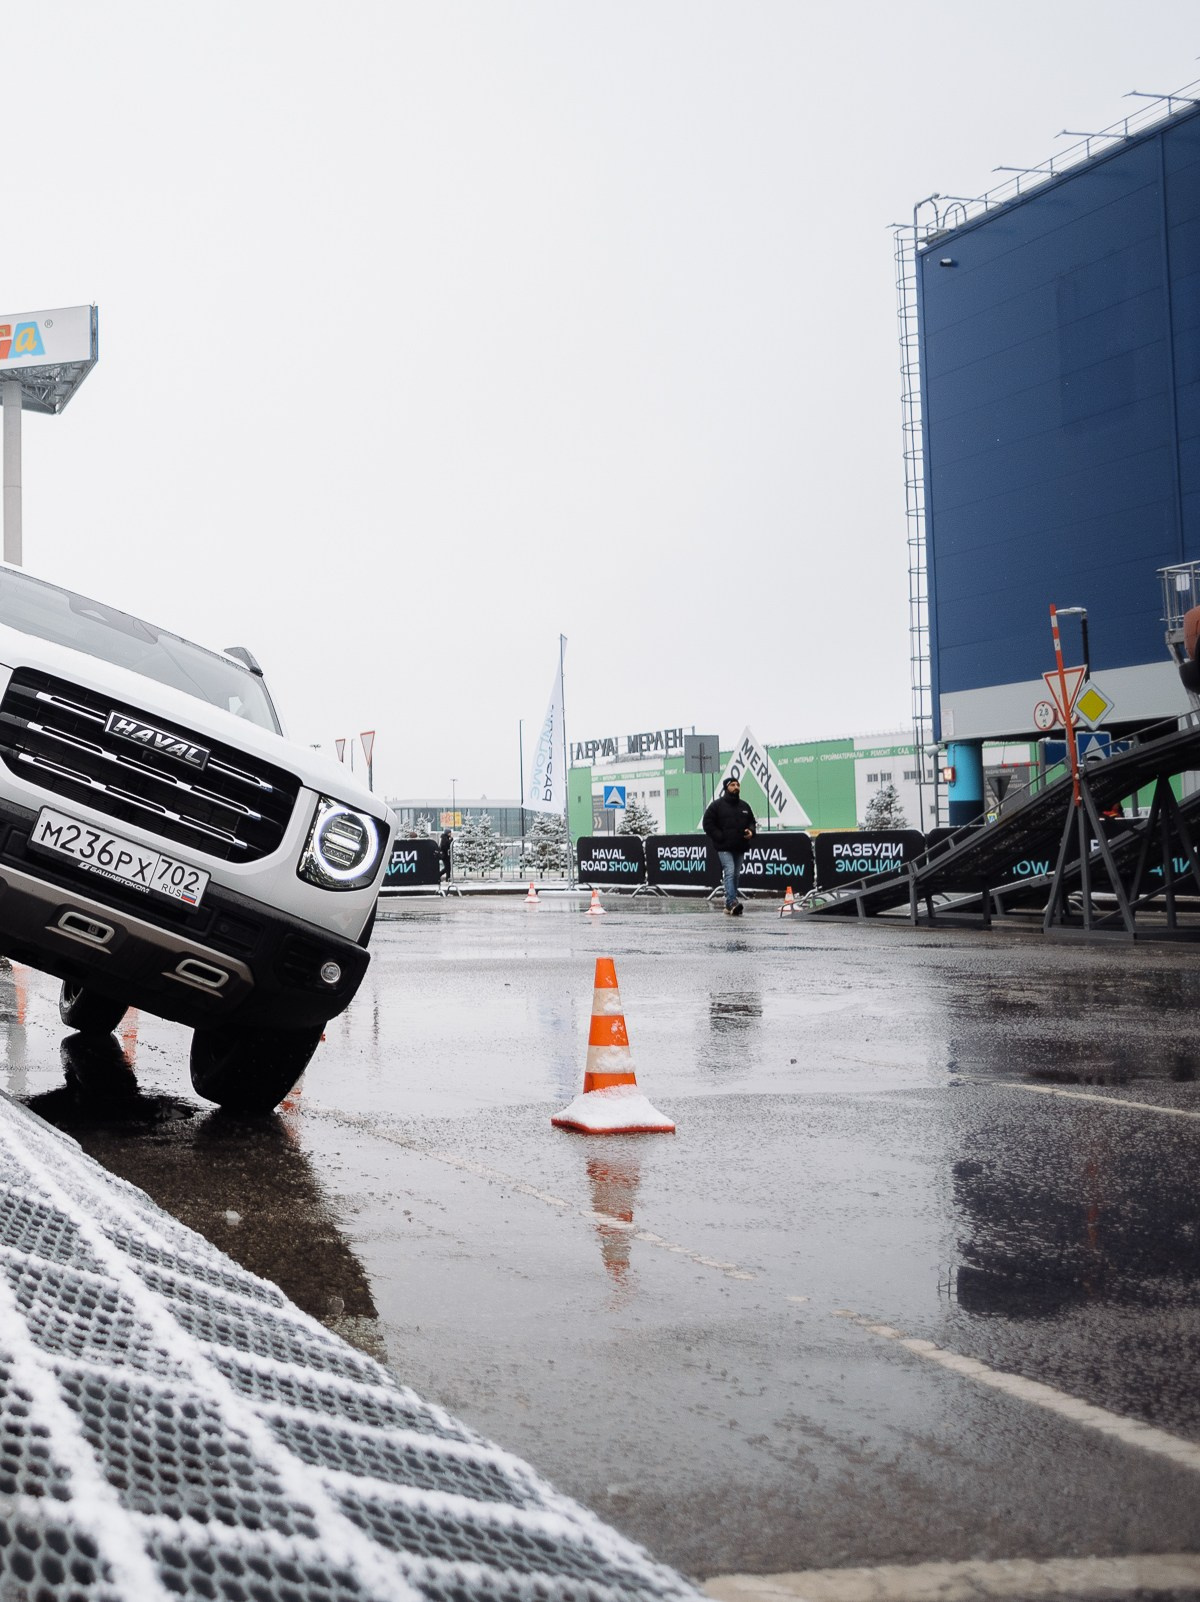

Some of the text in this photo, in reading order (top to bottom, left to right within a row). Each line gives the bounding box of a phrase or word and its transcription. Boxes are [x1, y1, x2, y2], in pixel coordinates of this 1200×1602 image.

[113, 719, 201, 764] HAVAL
[741, 737, 788, 814] MERLIN
[592, 849, 625, 860] HAVAL
[657, 846, 707, 860] РАЗБУДИ
[743, 848, 788, 861] HAVAL
[833, 842, 904, 859] РАЗБУДИ
[580, 860, 639, 873] ROAD SHOW
[659, 860, 706, 873] ЭМОЦИИ
[739, 862, 805, 876] OAD SHOW
[835, 859, 902, 874] ЭМОЦИИ
[157, 858, 200, 893] 702
[161, 883, 182, 898] RUS
